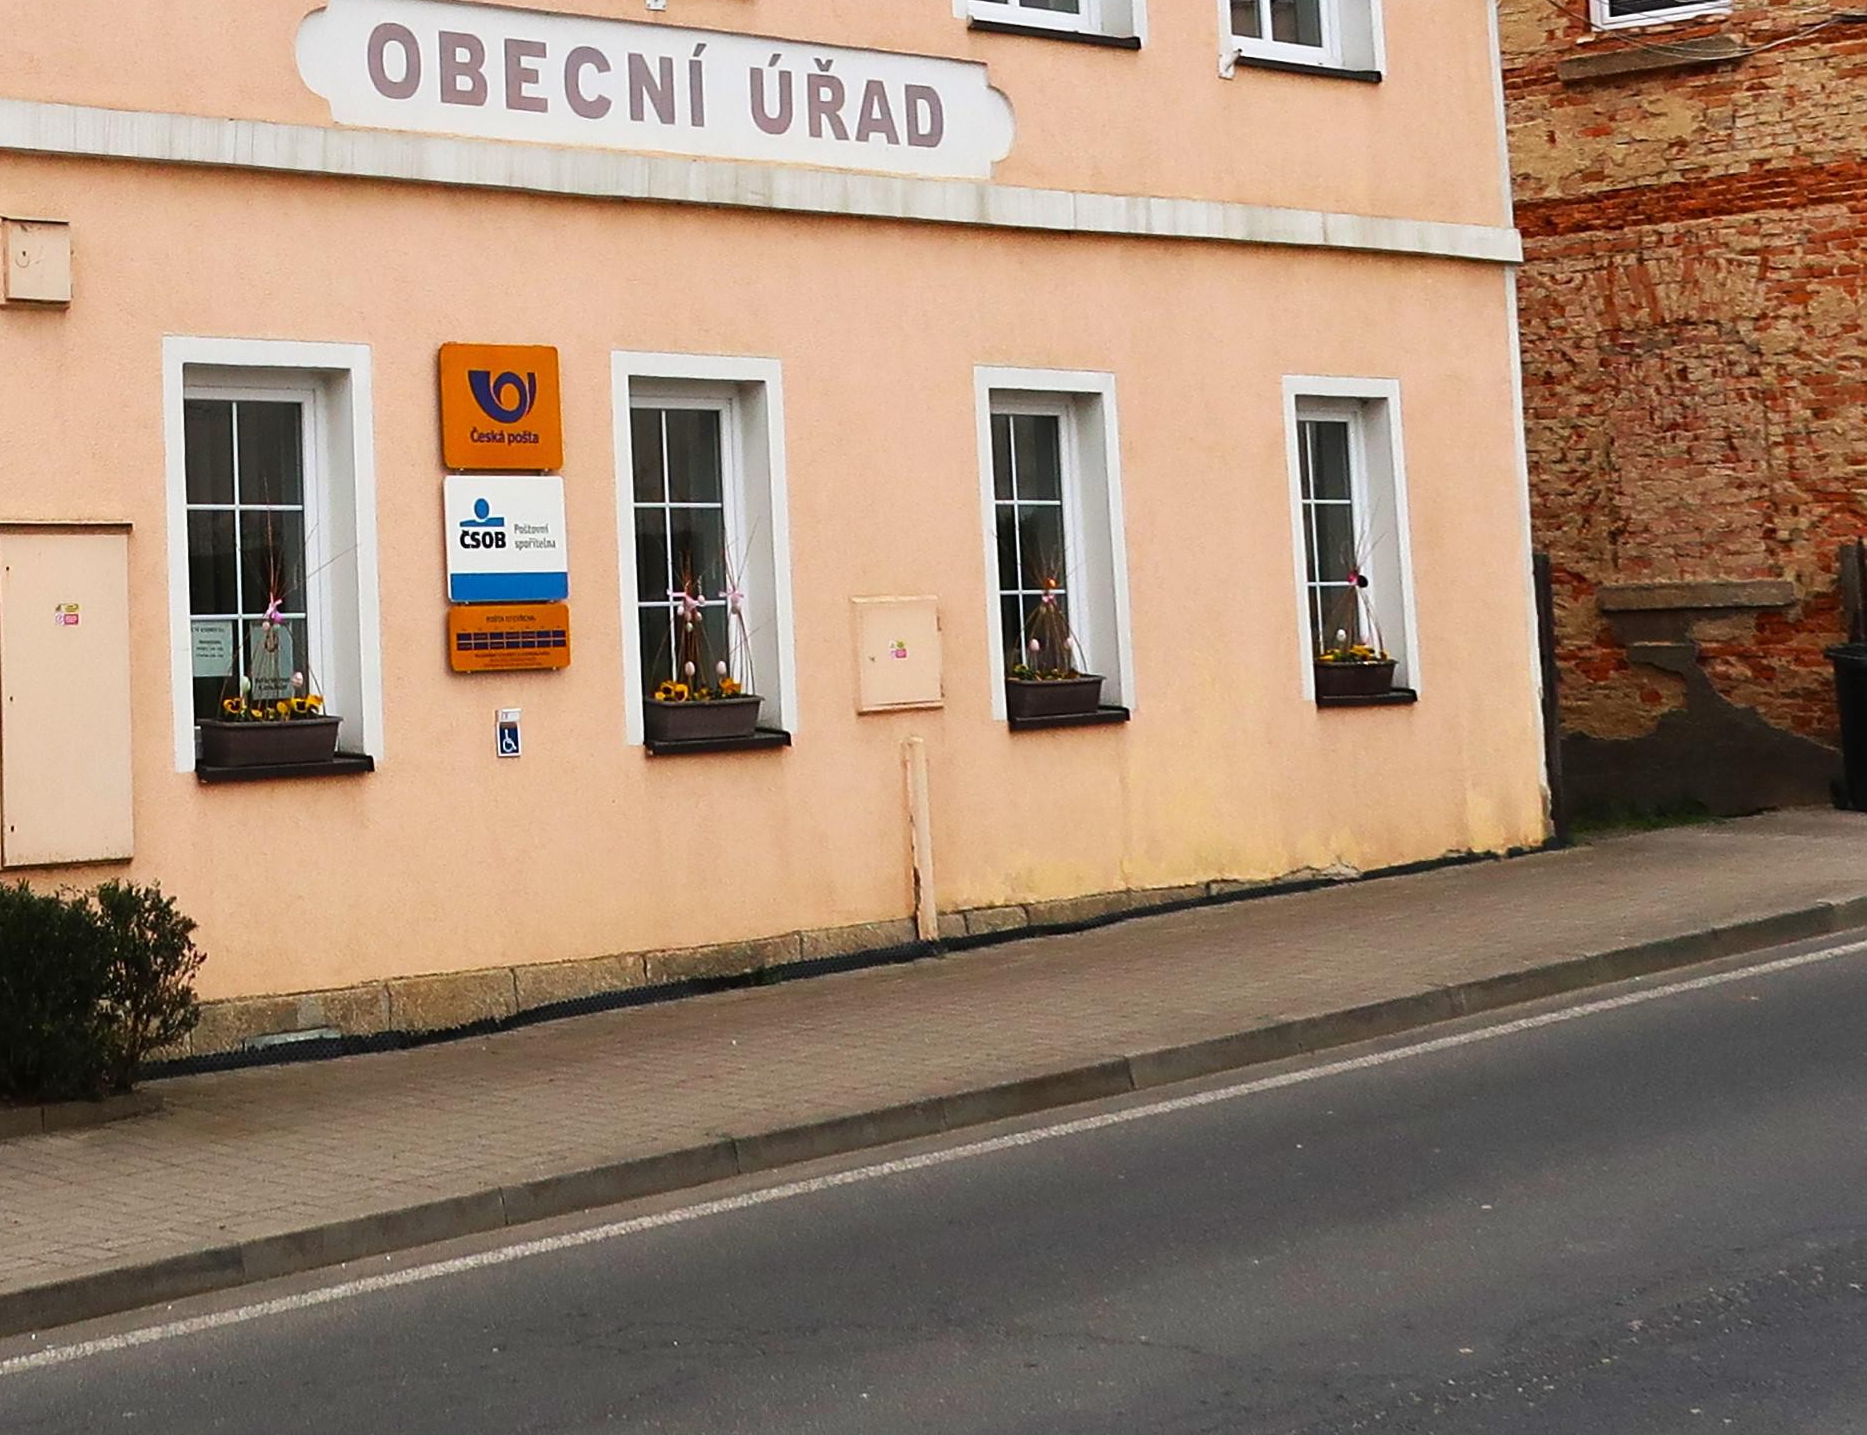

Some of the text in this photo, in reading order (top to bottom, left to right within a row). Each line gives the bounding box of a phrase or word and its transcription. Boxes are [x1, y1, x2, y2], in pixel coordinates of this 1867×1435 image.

[366, 21, 945, 150] OBECNÍ ÚŘAD
[470, 427, 539, 445] Česká pošta
[514, 523, 549, 534] Poštovní
[459, 529, 507, 549] ČSOB
[514, 538, 556, 550] spořitelna
